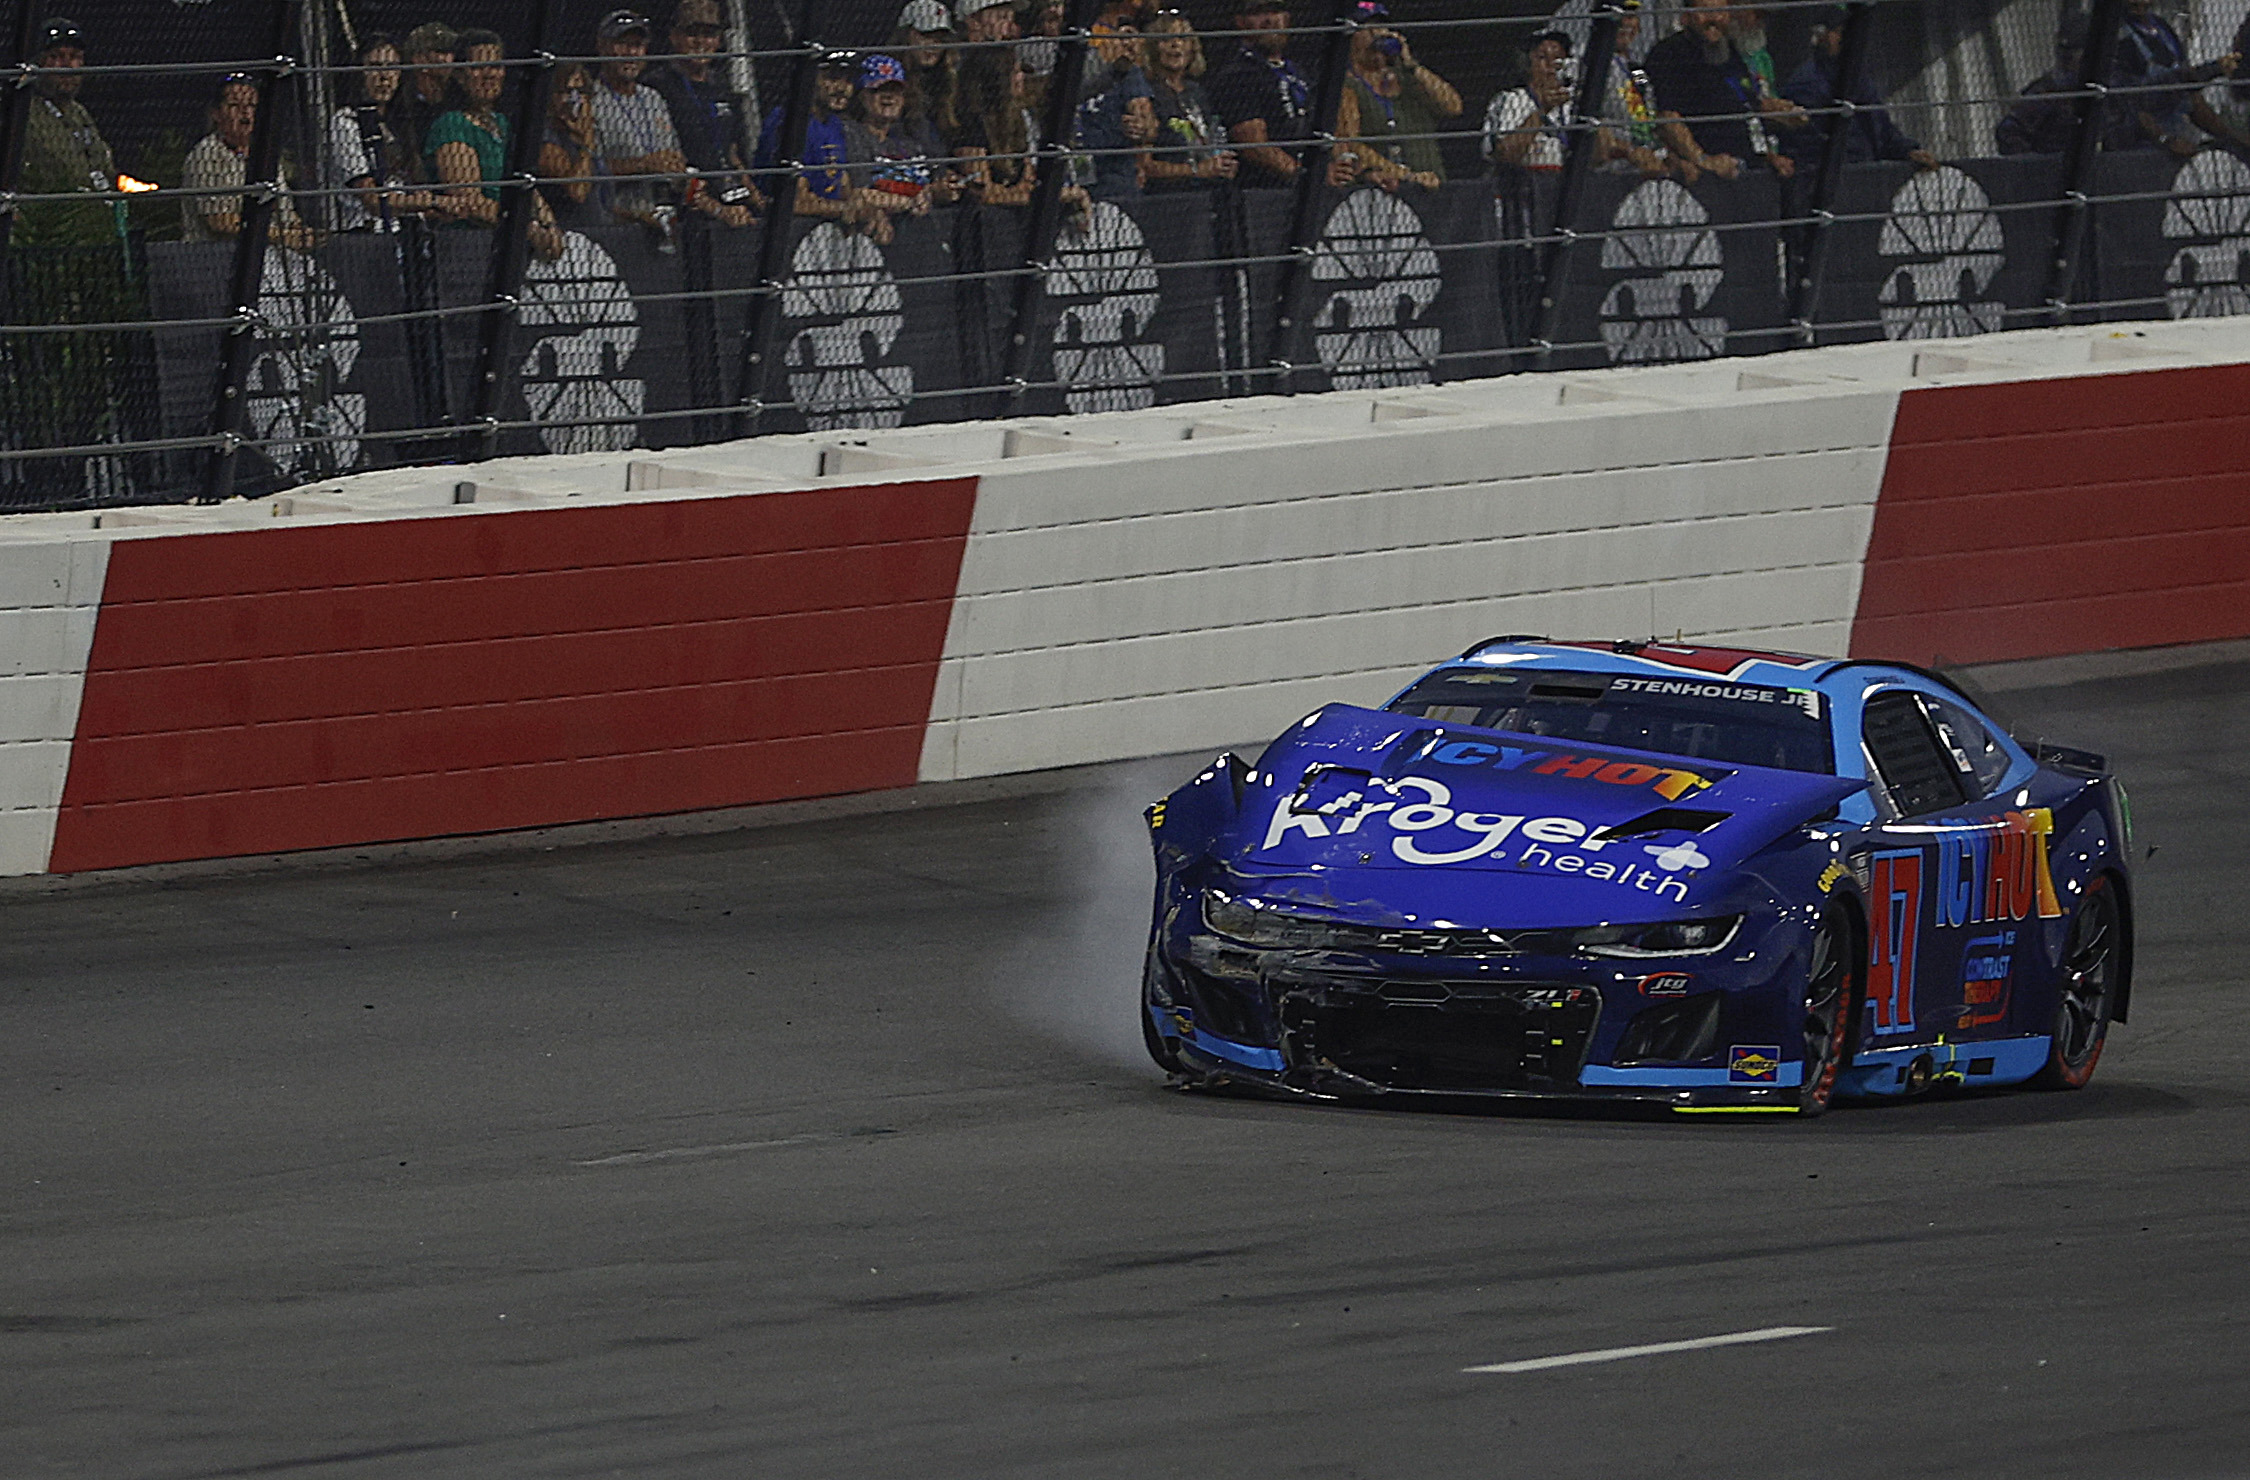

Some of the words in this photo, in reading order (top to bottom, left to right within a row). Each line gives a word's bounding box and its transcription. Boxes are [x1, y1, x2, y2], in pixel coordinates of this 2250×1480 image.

[1611, 678, 1775, 703] STENHOUSE
[1520, 843, 1689, 902] health
[1866, 848, 1923, 1036] 47
